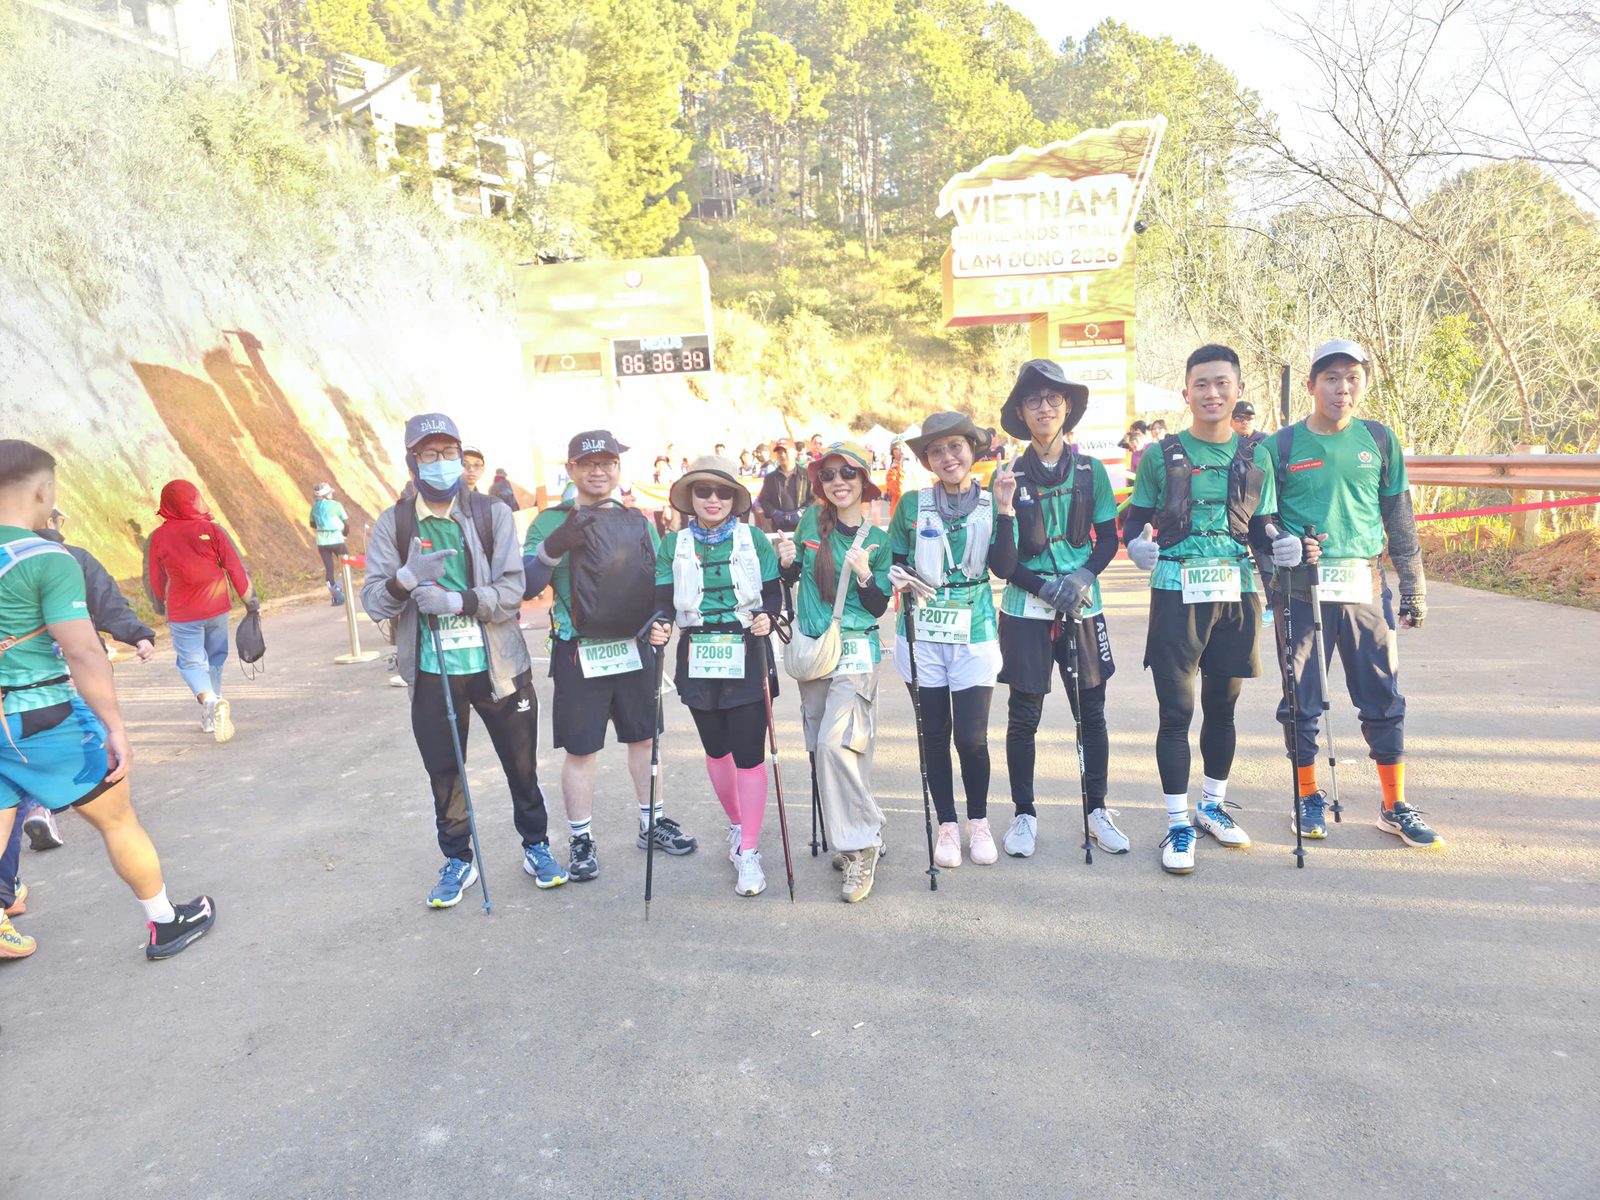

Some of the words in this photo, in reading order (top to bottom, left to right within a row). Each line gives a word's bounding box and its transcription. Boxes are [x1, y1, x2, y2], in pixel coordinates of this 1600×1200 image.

[957, 187, 1118, 224] VIETNAM
[1071, 248, 1118, 265] 2026
[994, 276, 1095, 308] START
[919, 608, 959, 625] F2077
[586, 643, 629, 661] M2008
[696, 645, 733, 659] F2089
